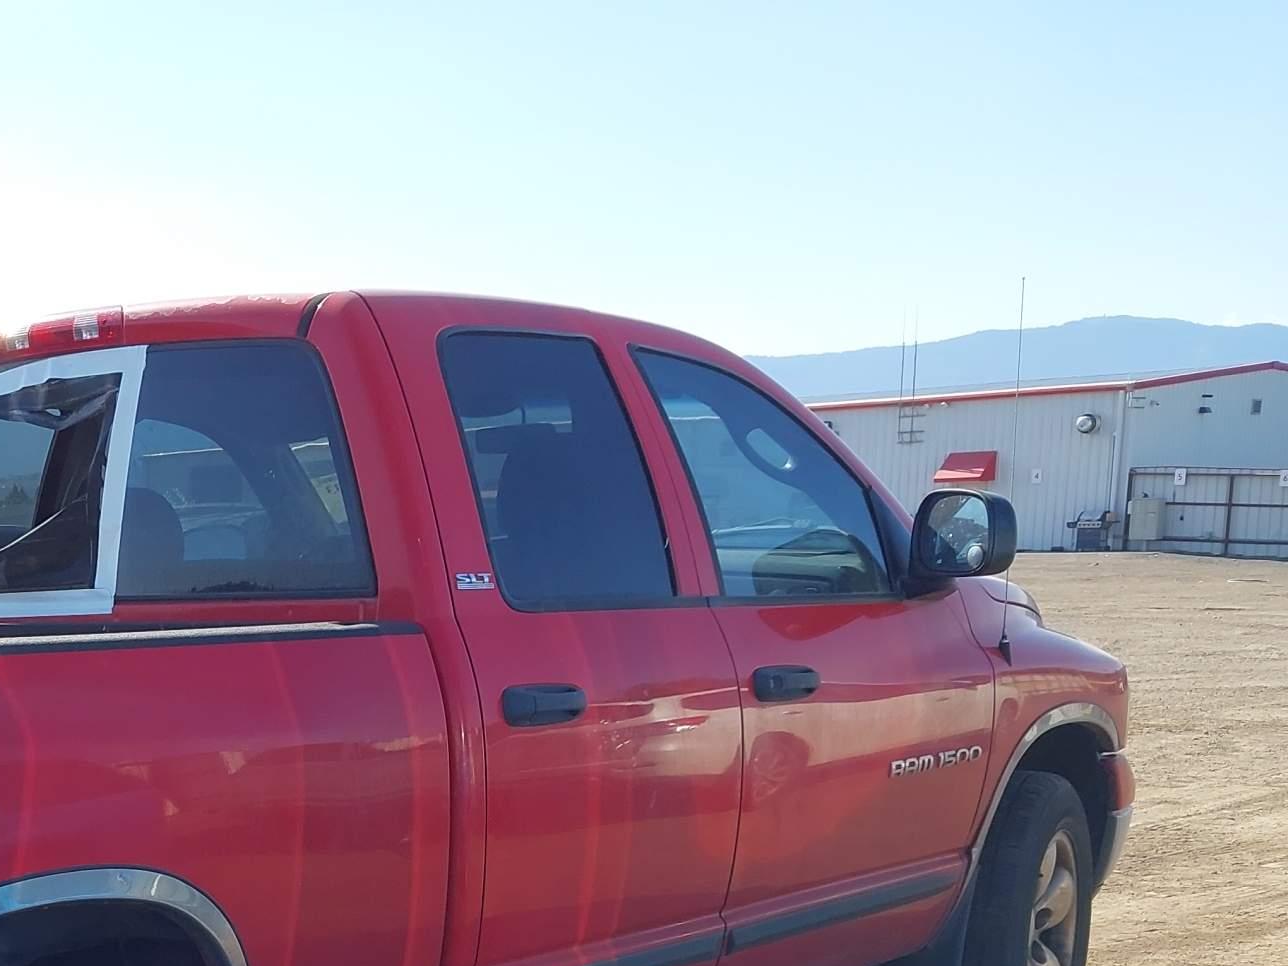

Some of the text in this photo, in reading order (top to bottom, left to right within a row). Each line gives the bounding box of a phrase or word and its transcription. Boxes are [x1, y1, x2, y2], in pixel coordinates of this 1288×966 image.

[456, 573, 491, 583] SLT
[889, 745, 983, 778] RAM 1500
